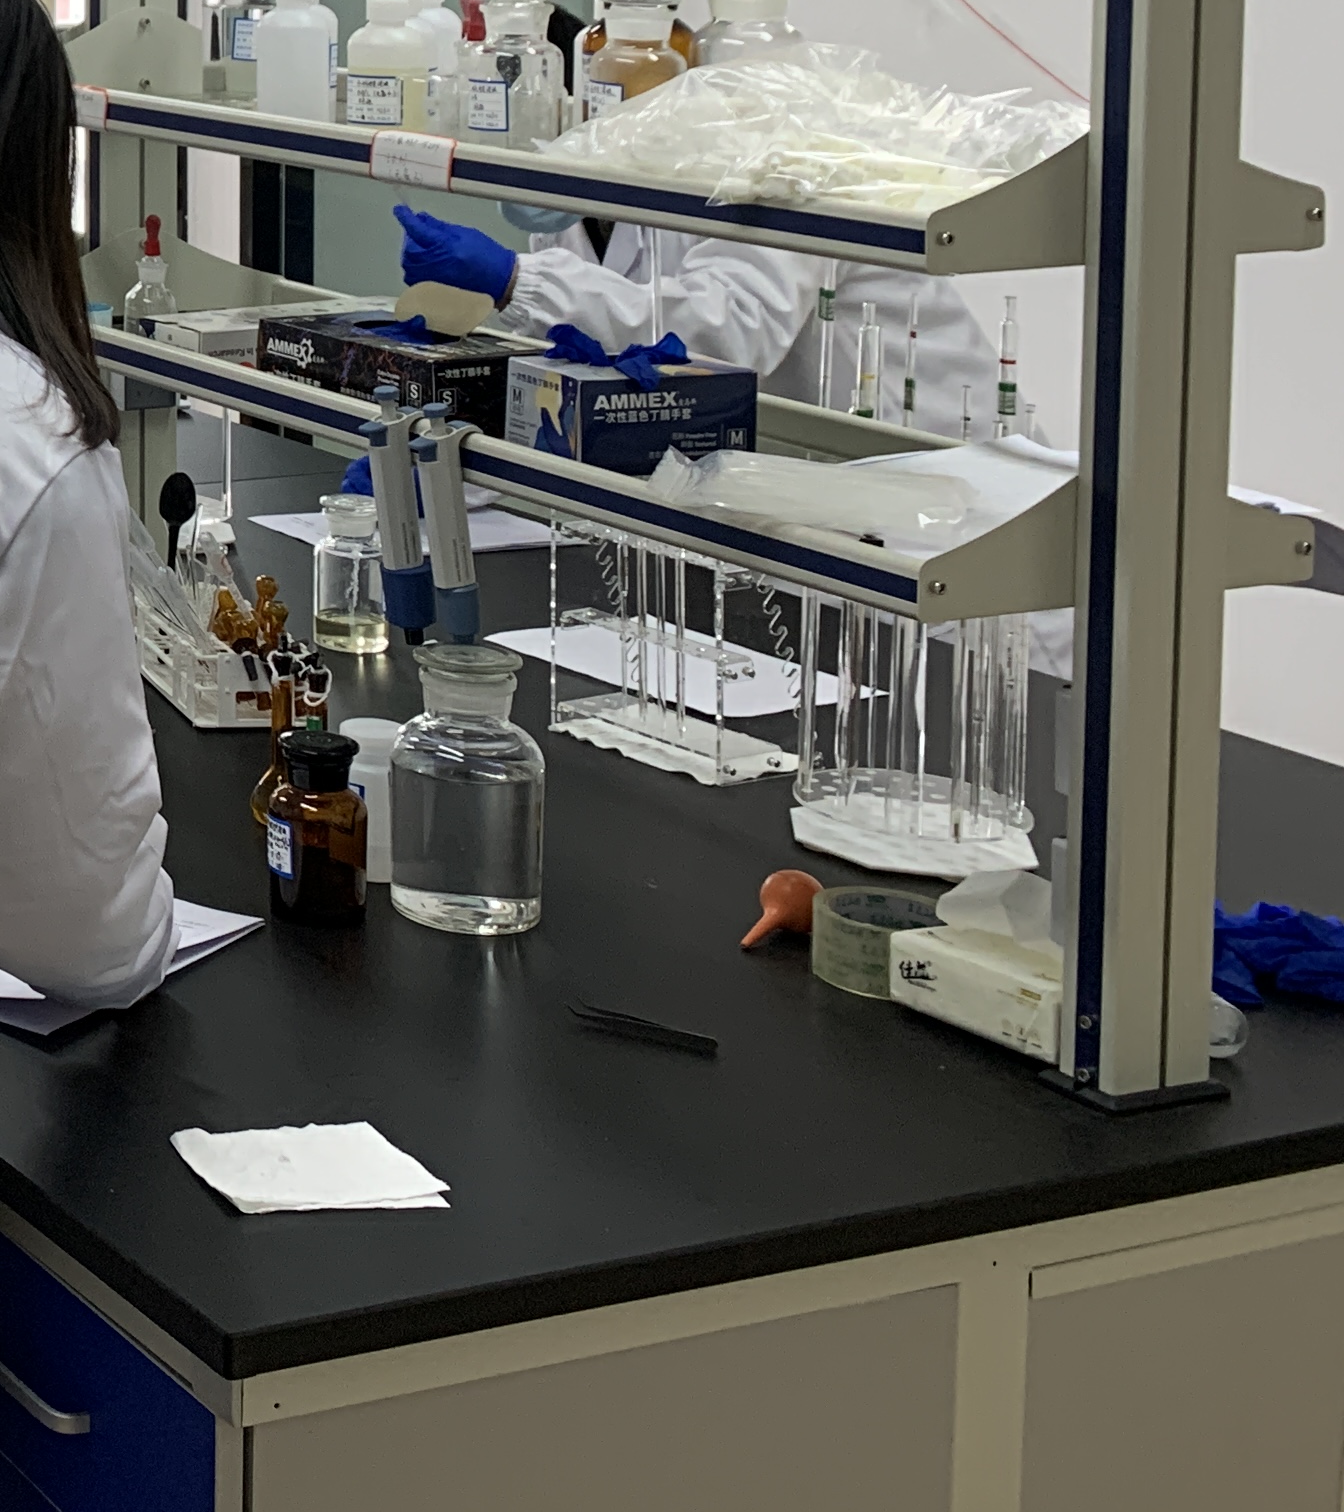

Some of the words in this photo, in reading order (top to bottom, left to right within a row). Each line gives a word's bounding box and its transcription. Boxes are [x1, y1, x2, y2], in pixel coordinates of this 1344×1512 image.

[267, 337, 308, 362] AMMEX
[409, 384, 419, 399] S
[442, 390, 453, 406] S
[512, 388, 522, 404] M
[593, 391, 677, 411] AMMEX
[593, 408, 692, 424] 一次性蓝色丁腈手套
[730, 430, 744, 446] M
